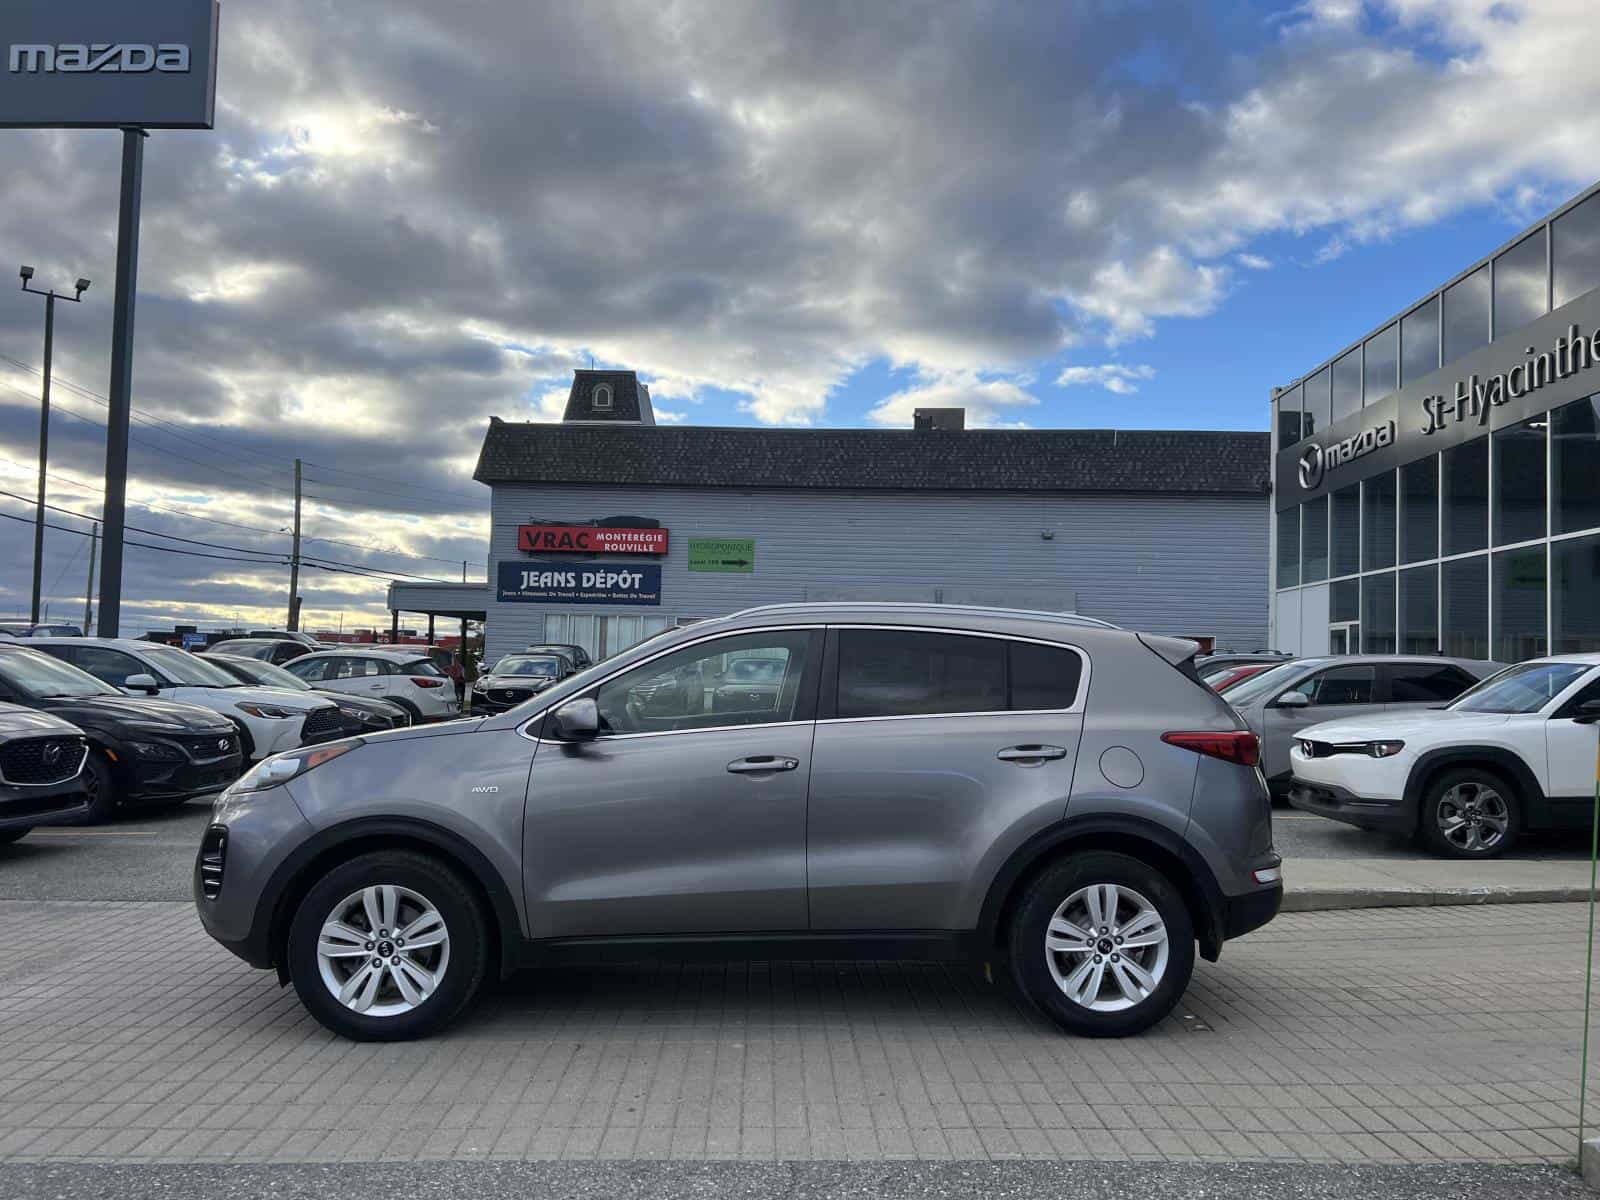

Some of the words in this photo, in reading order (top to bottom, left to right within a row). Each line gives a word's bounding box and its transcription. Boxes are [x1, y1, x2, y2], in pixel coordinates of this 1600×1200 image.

[9, 43, 191, 72] mazda
[1324, 419, 1395, 472] mazda
[525, 531, 590, 549] VRAC
[596, 531, 663, 542] MONTÉRÉGIE
[604, 543, 655, 552] ROUVILLE
[520, 571, 576, 589] JEANS
[582, 569, 643, 589] DÉPÔT
